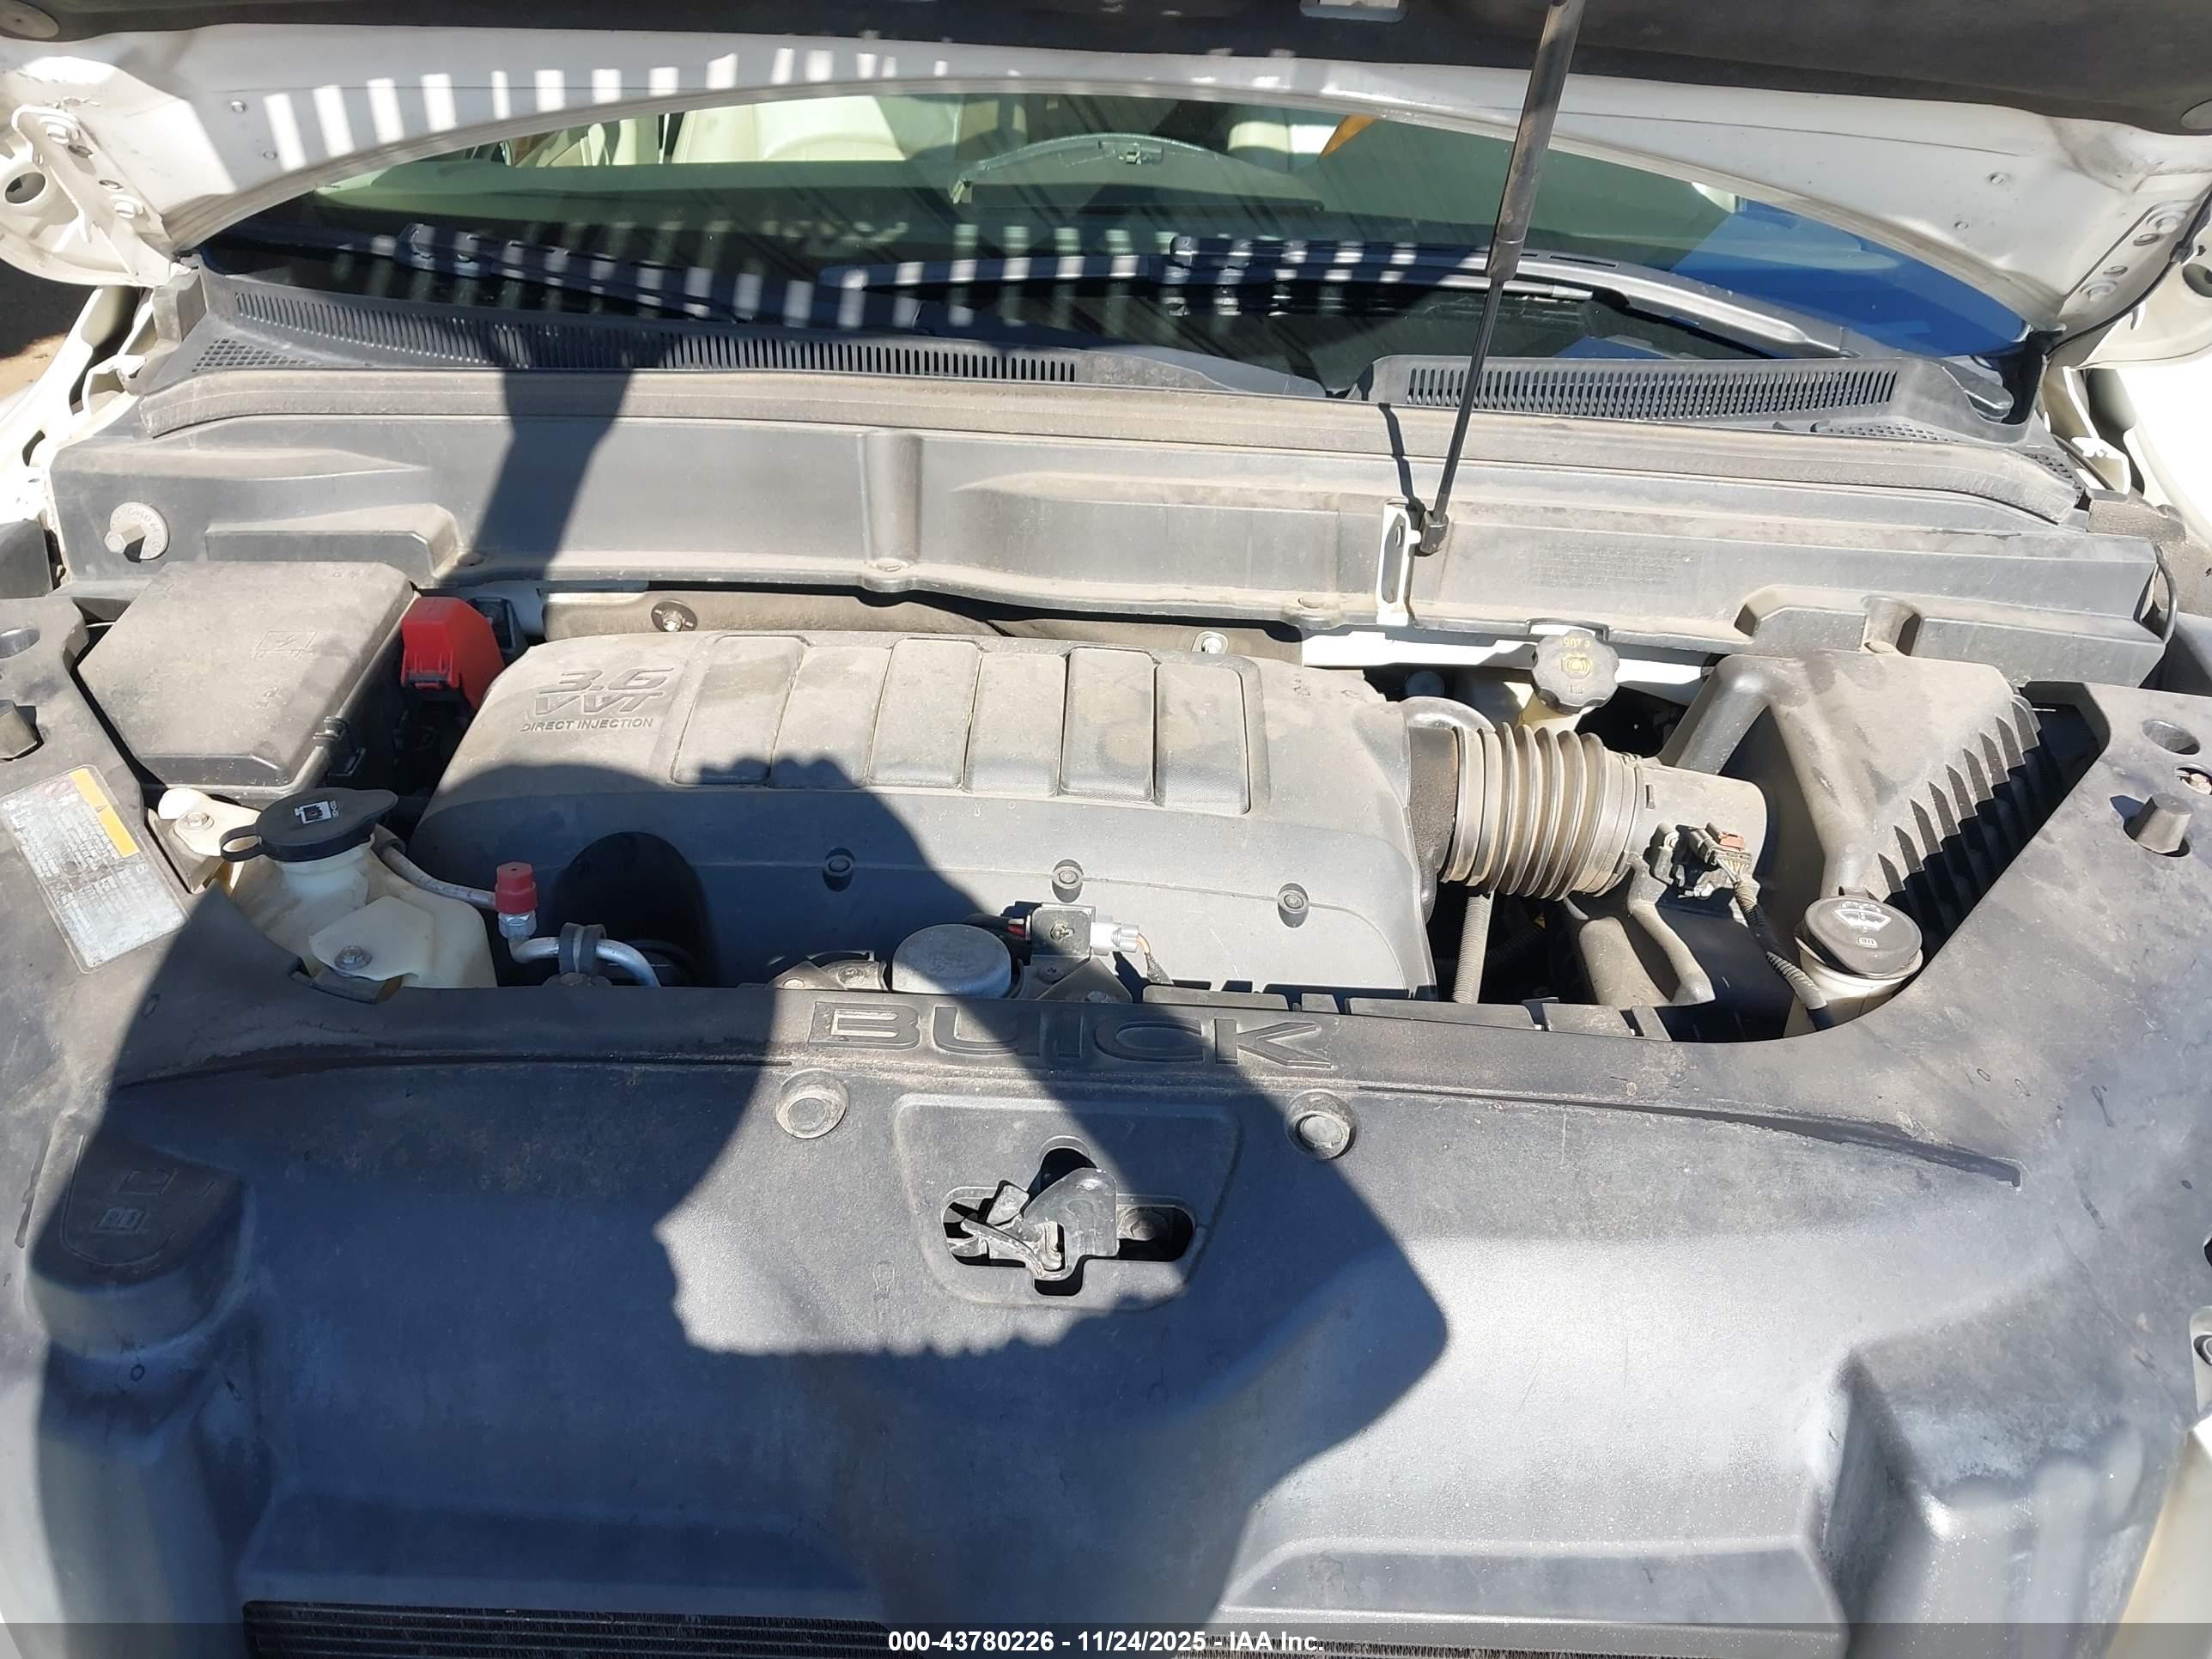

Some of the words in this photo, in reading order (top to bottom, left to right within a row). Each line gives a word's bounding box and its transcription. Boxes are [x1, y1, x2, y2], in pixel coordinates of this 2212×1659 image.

[539, 666, 674, 695] 3.6
[535, 691, 665, 716] VVT
[520, 720, 575, 732] DIRECT
[576, 717, 653, 731] INJECTION
[806, 1000, 1334, 1069] BUICK
